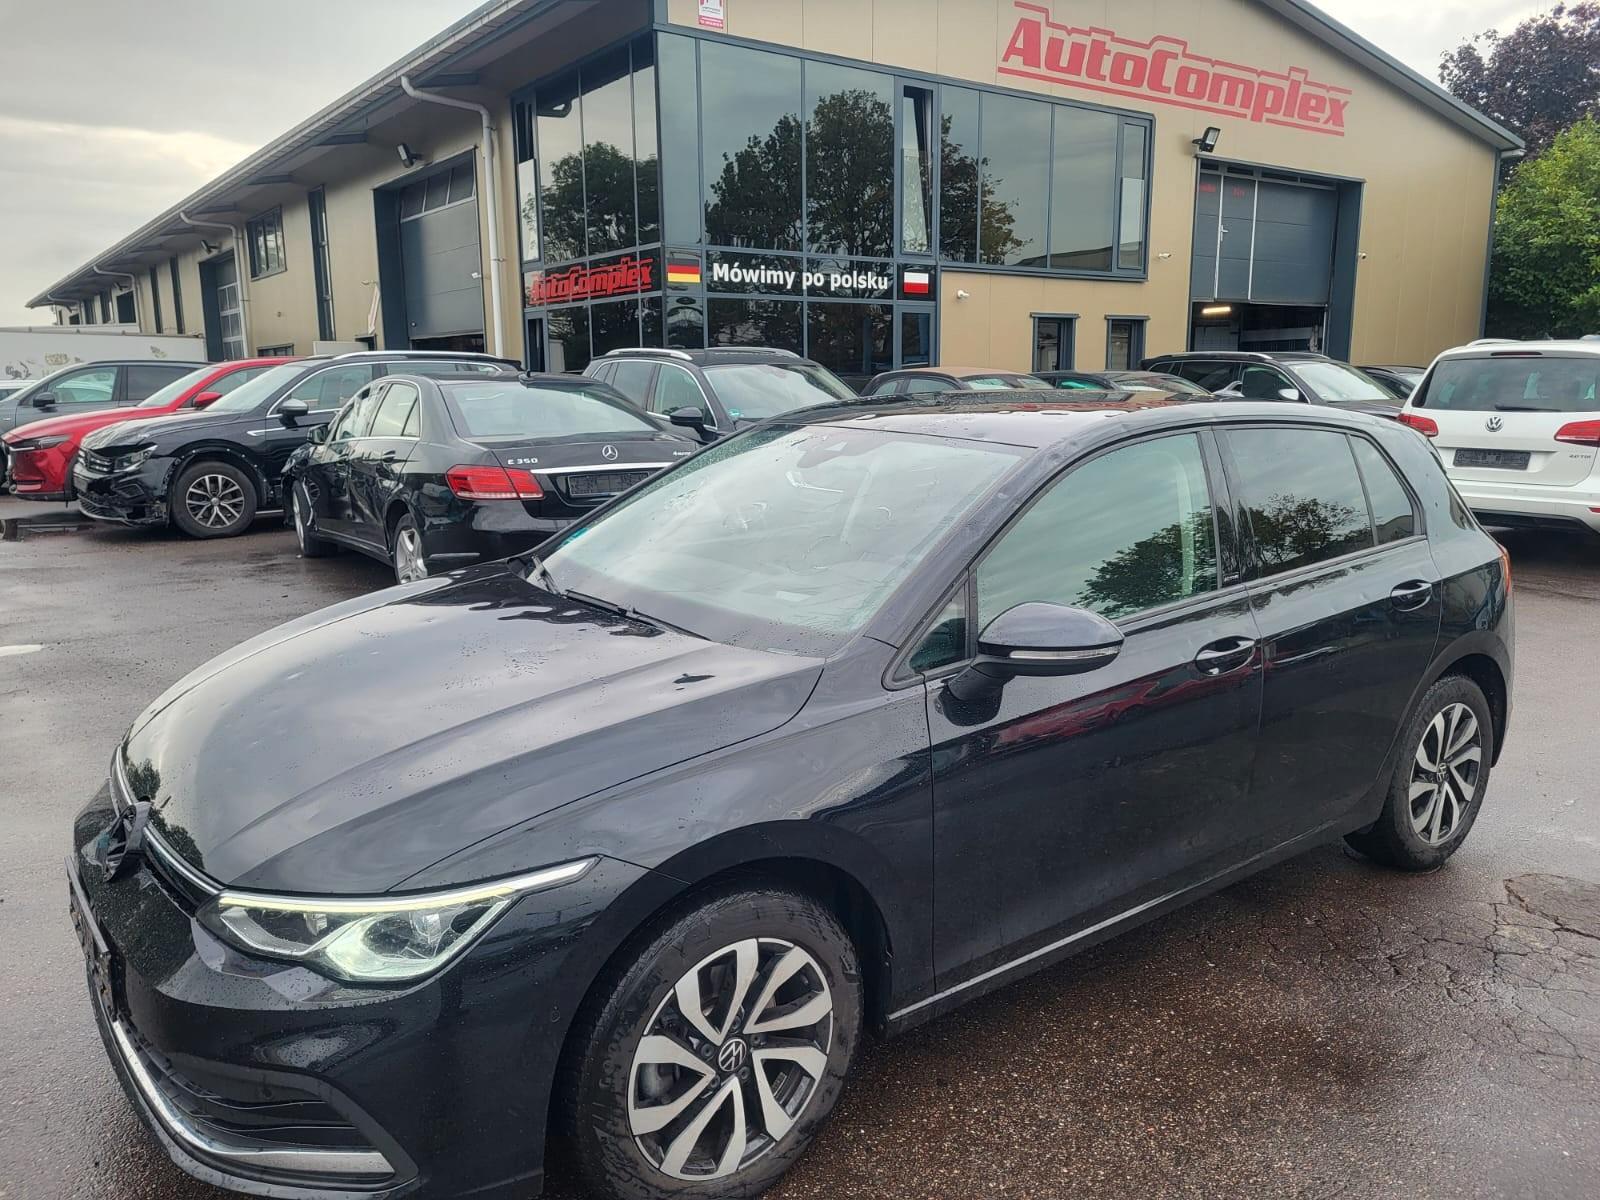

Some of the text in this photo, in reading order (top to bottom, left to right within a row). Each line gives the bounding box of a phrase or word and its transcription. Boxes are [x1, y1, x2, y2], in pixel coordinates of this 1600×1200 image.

[1001, 16, 1350, 128] AutoComplex
[530, 263, 652, 302] AutoComplex
[712, 262, 888, 291] Mówimy po polsku
[516, 457, 539, 465] 350
